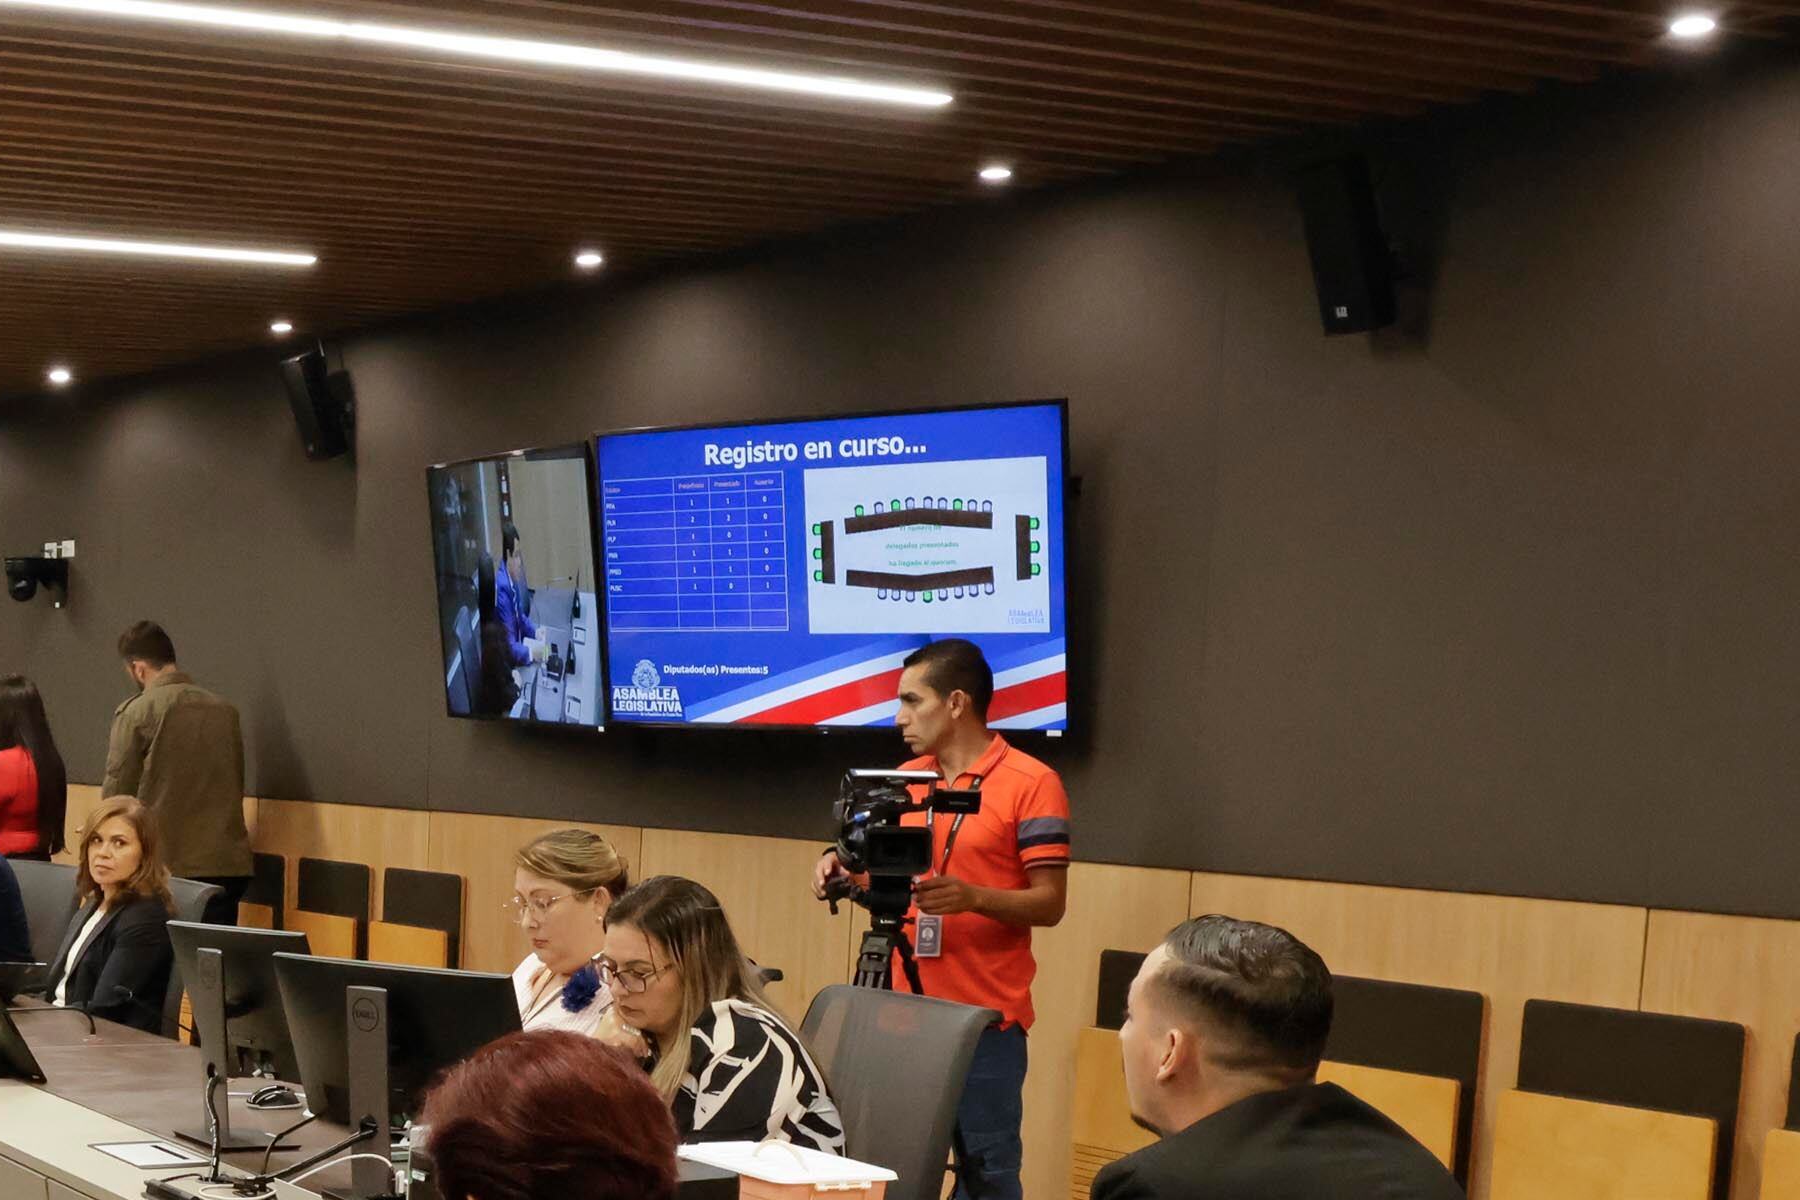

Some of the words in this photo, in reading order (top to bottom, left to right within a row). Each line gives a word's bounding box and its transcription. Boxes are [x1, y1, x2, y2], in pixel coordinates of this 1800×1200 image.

[704, 441, 798, 469] Registro
[804, 441, 832, 459] en
[839, 436, 927, 457] curso...
[663, 664, 719, 676] Diputados(as)
[613, 688, 680, 700] ASAMBLEA
[613, 701, 682, 712] LEGISLATIVA
